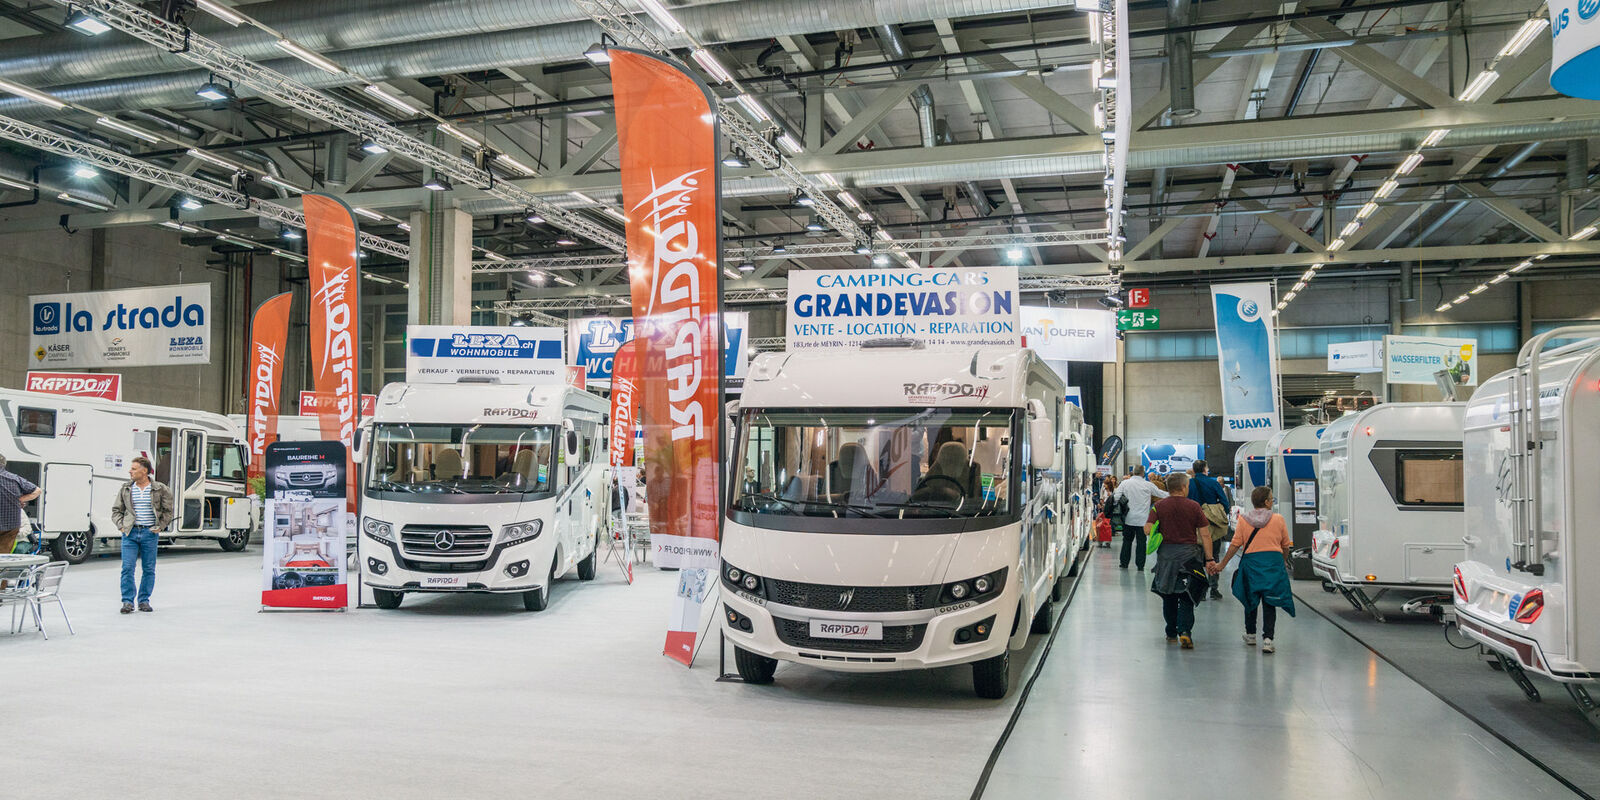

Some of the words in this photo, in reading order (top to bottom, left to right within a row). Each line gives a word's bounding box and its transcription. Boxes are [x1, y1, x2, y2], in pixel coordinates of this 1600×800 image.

[816, 271, 989, 288] CAMPING-CARS
[794, 290, 1012, 318] GRANDEVASION
[1134, 291, 1142, 303] F
[65, 302, 93, 333] la
[103, 296, 205, 331] strada
[794, 323, 834, 336] VENTE
[847, 322, 916, 335] LOCATION
[929, 321, 1013, 334] REPARATION
[169, 336, 203, 346] LEXA
[451, 333, 534, 349] LEXA.ch
[451, 349, 519, 357] WOHNMOBILE
[1391, 354, 1440, 365] WASSERFILTER
[30, 377, 98, 391] RAPIDO
[903, 383, 974, 396] RAPIDO
[254, 363, 273, 455] RAPIDO
[483, 408, 529, 417] RAPIDO
[613, 392, 629, 464] RAPIDO
[820, 623, 860, 634] RAPIDO
